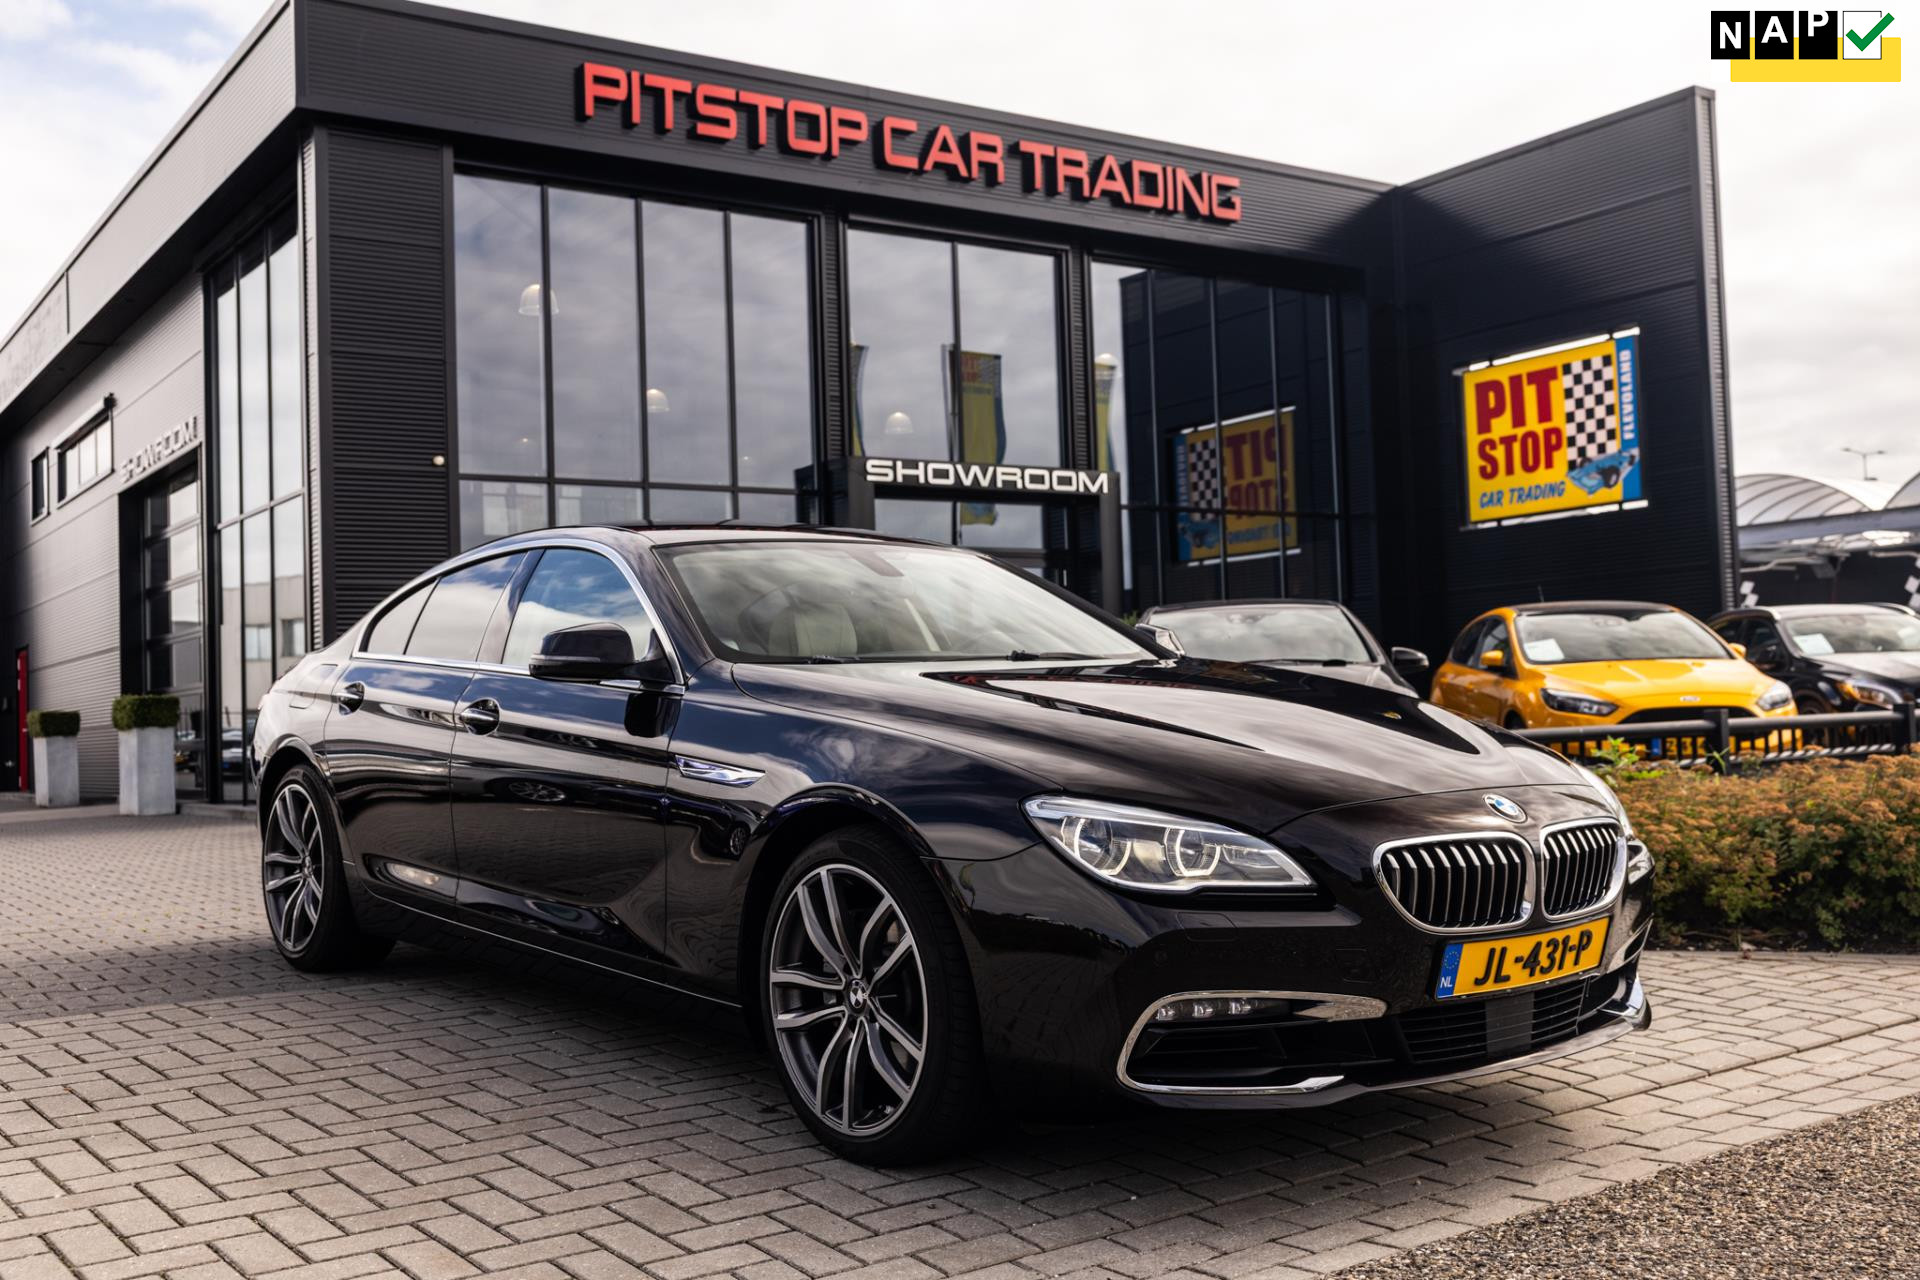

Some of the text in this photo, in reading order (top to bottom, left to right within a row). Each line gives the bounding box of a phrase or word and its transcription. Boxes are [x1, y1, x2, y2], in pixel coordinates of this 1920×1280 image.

[583, 62, 1242, 223] PITSTOP CAR TRADING
[1474, 366, 1559, 435] PIT
[1619, 349, 1636, 440] FLEVOLAND
[865, 459, 1109, 494] SHOWROOM
[1477, 427, 1563, 480] STOP
[1479, 481, 1566, 509] CAR TRADING
[1439, 975, 1454, 988] NL
[1473, 929, 1594, 986] JL-431-P
